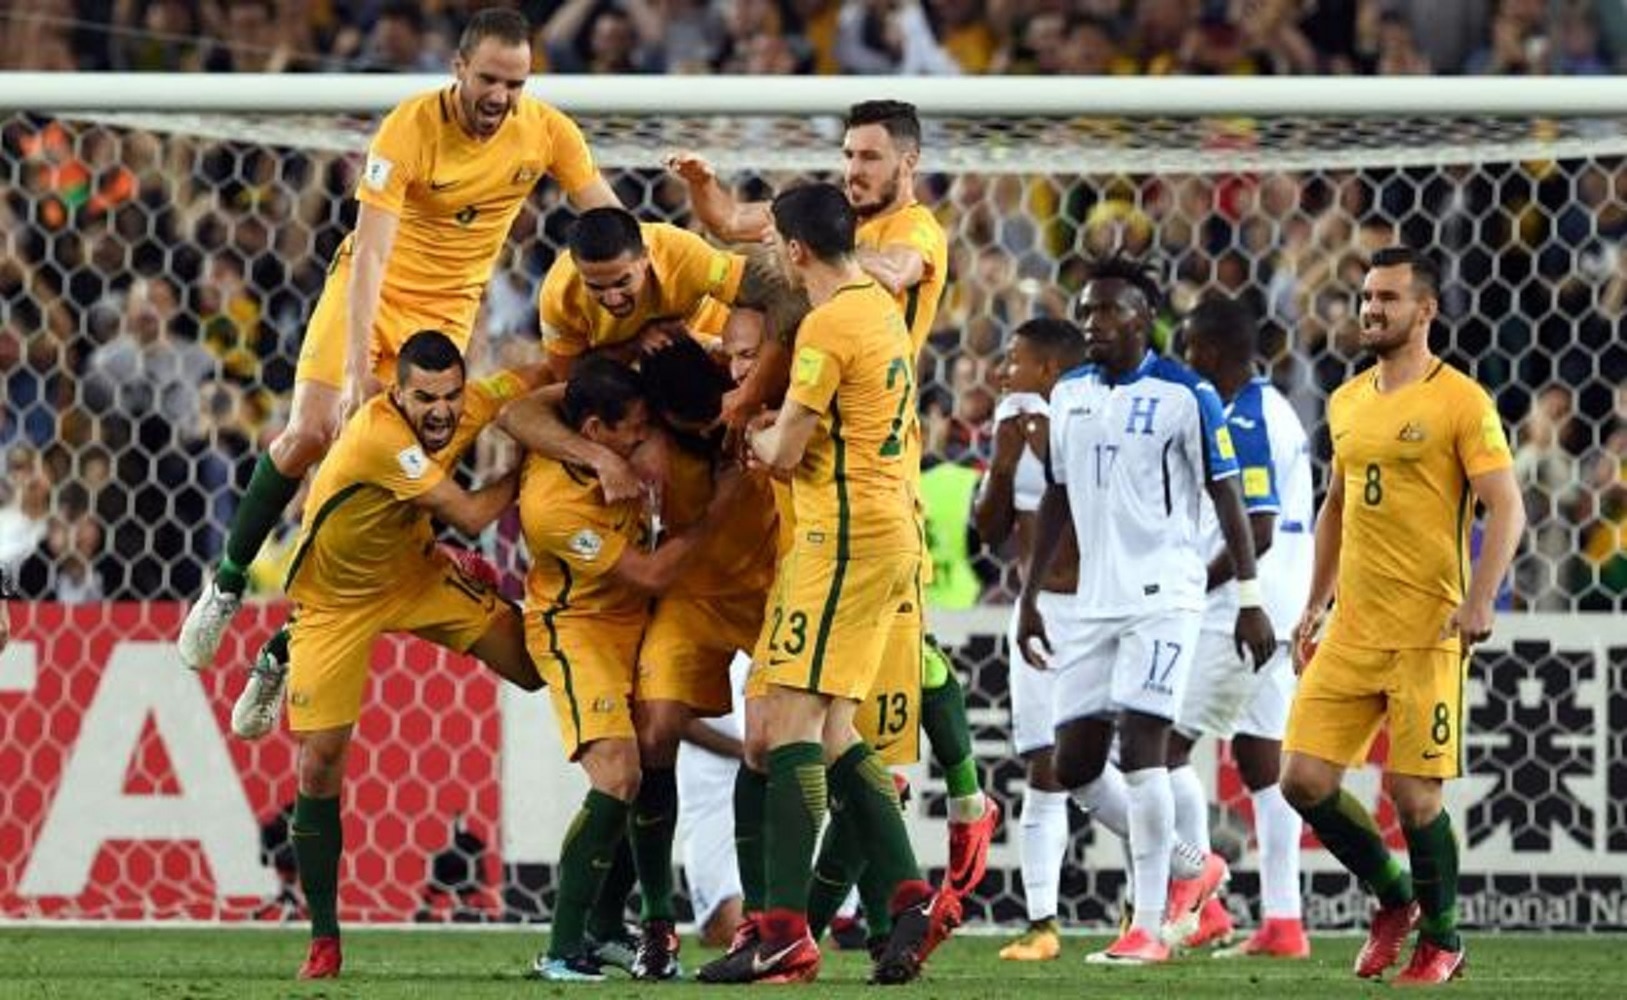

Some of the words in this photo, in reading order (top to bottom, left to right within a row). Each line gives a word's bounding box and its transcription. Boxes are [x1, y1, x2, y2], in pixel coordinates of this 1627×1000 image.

[1125, 397, 1160, 435] H
[1095, 444, 1119, 488] 17
[1364, 463, 1382, 506] 8
[769, 606, 808, 655] 23
[1149, 639, 1181, 682] 17
[877, 692, 908, 736] 13
[1432, 702, 1450, 746] 8
